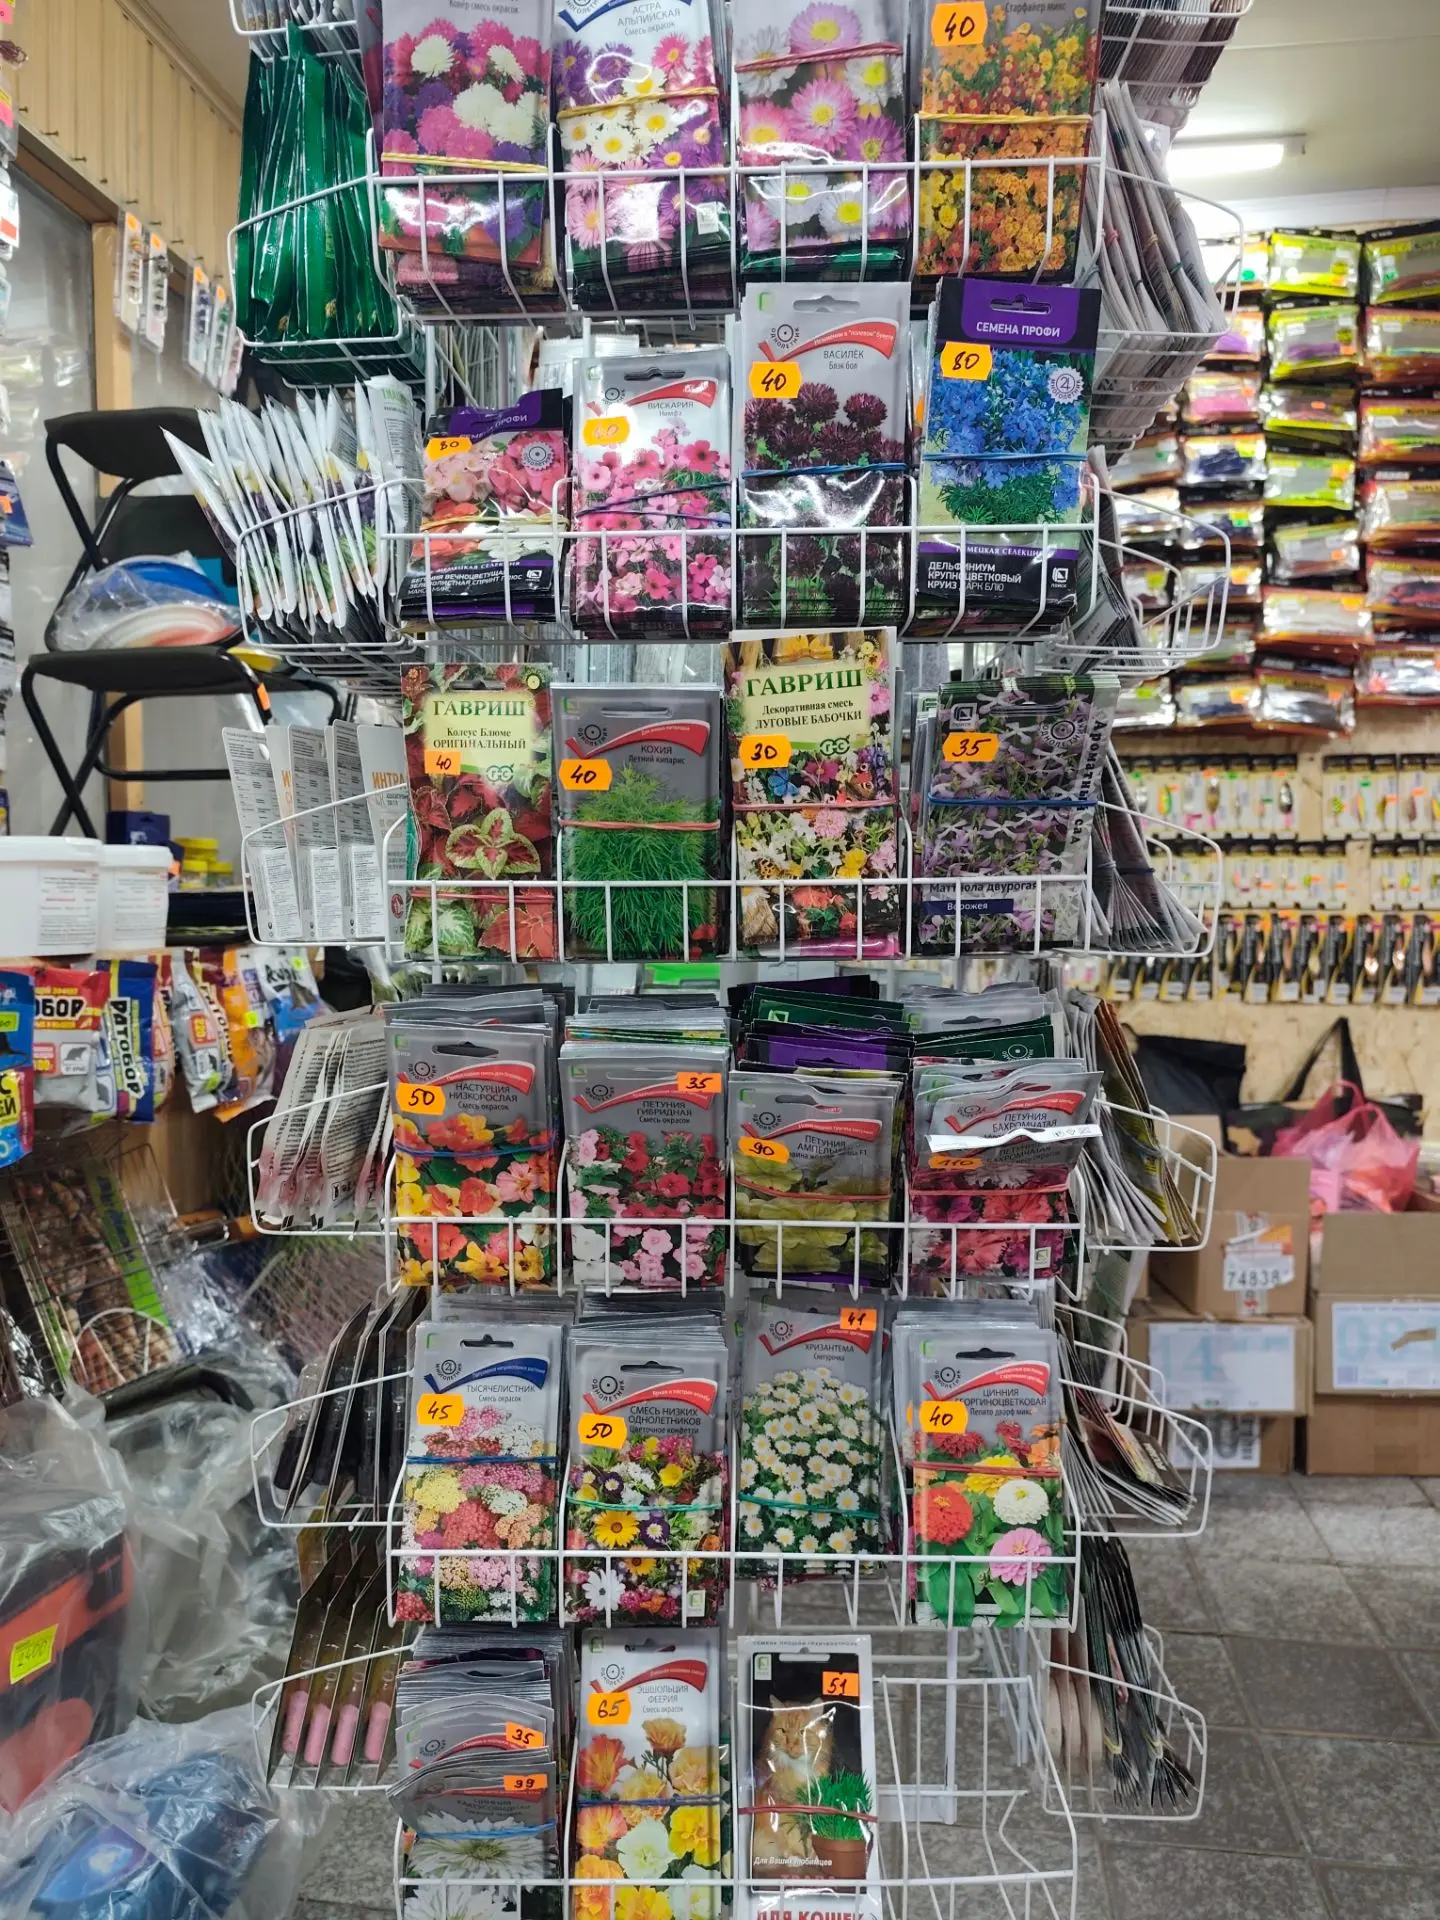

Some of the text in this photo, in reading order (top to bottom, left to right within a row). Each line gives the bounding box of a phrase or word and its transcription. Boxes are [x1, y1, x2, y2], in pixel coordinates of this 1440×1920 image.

[632, 2, 661, 15] АСТРА
[617, 8, 681, 27] АЛЬПИЙСКАЯ
[624, 26, 647, 37] Смесь
[944, 12, 975, 41] 40
[977, 321, 1061, 338] СЕМЕНА ПРОФИ
[953, 351, 980, 371] 80
[761, 369, 787, 392] 40
[647, 401, 694, 410] ВИСКАРИЯ
[444, 570, 506, 580] ВЕЧНОЦВЕТУЩА
[927, 580, 1005, 592] КРУИЗ АРК БЛЮ
[744, 668, 864, 698] ГАВРИШ
[432, 700, 526, 717] ГАВРИШ
[761, 699, 854, 716] Декоративная смесь
[755, 710, 862, 730] ЛУГОВЫЕ БАБОЧКИ
[447, 727, 512, 738] Колеус Блюме
[433, 738, 526, 750] ОРИГИНАЛЬНЫЙ
[640, 744, 673, 754] КОХИЯ
[951, 738, 992, 757] 35
[436, 755, 452, 770] 40
[628, 754, 686, 766] Летний кипарис
[570, 765, 597, 784] 40
[109, 999, 144, 1095] РАТОБОР
[455, 1083, 511, 1094] НАСТУРЦИЯ
[685, 1077, 713, 1090] 35
[408, 1087, 435, 1107] 50
[449, 1092, 518, 1103] НИЗКОРОСЛАЯ
[457, 1101, 509, 1111] Смесь окрасок
[642, 1100, 686, 1109] ПЕТУНИЯ
[636, 1108, 692, 1117] ГИБРИДНАЯ
[1004, 1112, 1047, 1122] ПЕТУНИЯ
[639, 1116, 690, 1125] Смесь окрасок
[804, 1134, 846, 1147] ПЕТУНИЯ
[749, 1141, 775, 1156] 90
[804, 1343, 855, 1353] ХРИЗАНТЕМА
[467, 1384, 537, 1393] ТЫСЯЧЕЛИСТНИК
[982, 1388, 1020, 1398] ЦИННИЯ
[478, 1394, 522, 1403] Смесь окрасок
[427, 1401, 453, 1420] 45
[629, 1405, 698, 1417] СМЕСЬ НИЗКИХ
[929, 1405, 953, 1427] 40
[628, 1415, 701, 1426] ОДНОЛЕТНИКОВ
[585, 1422, 613, 1439] 50
[629, 1425, 699, 1435] Цветочное конфетти
[826, 1677, 848, 1695] 51
[647, 1695, 678, 1704] ФЕЕРИЯ
[597, 1699, 626, 1719] 65
[641, 1704, 684, 1714] Смесь окрасок
[511, 1728, 535, 1745] 35
[752, 1856, 768, 1866] Для
